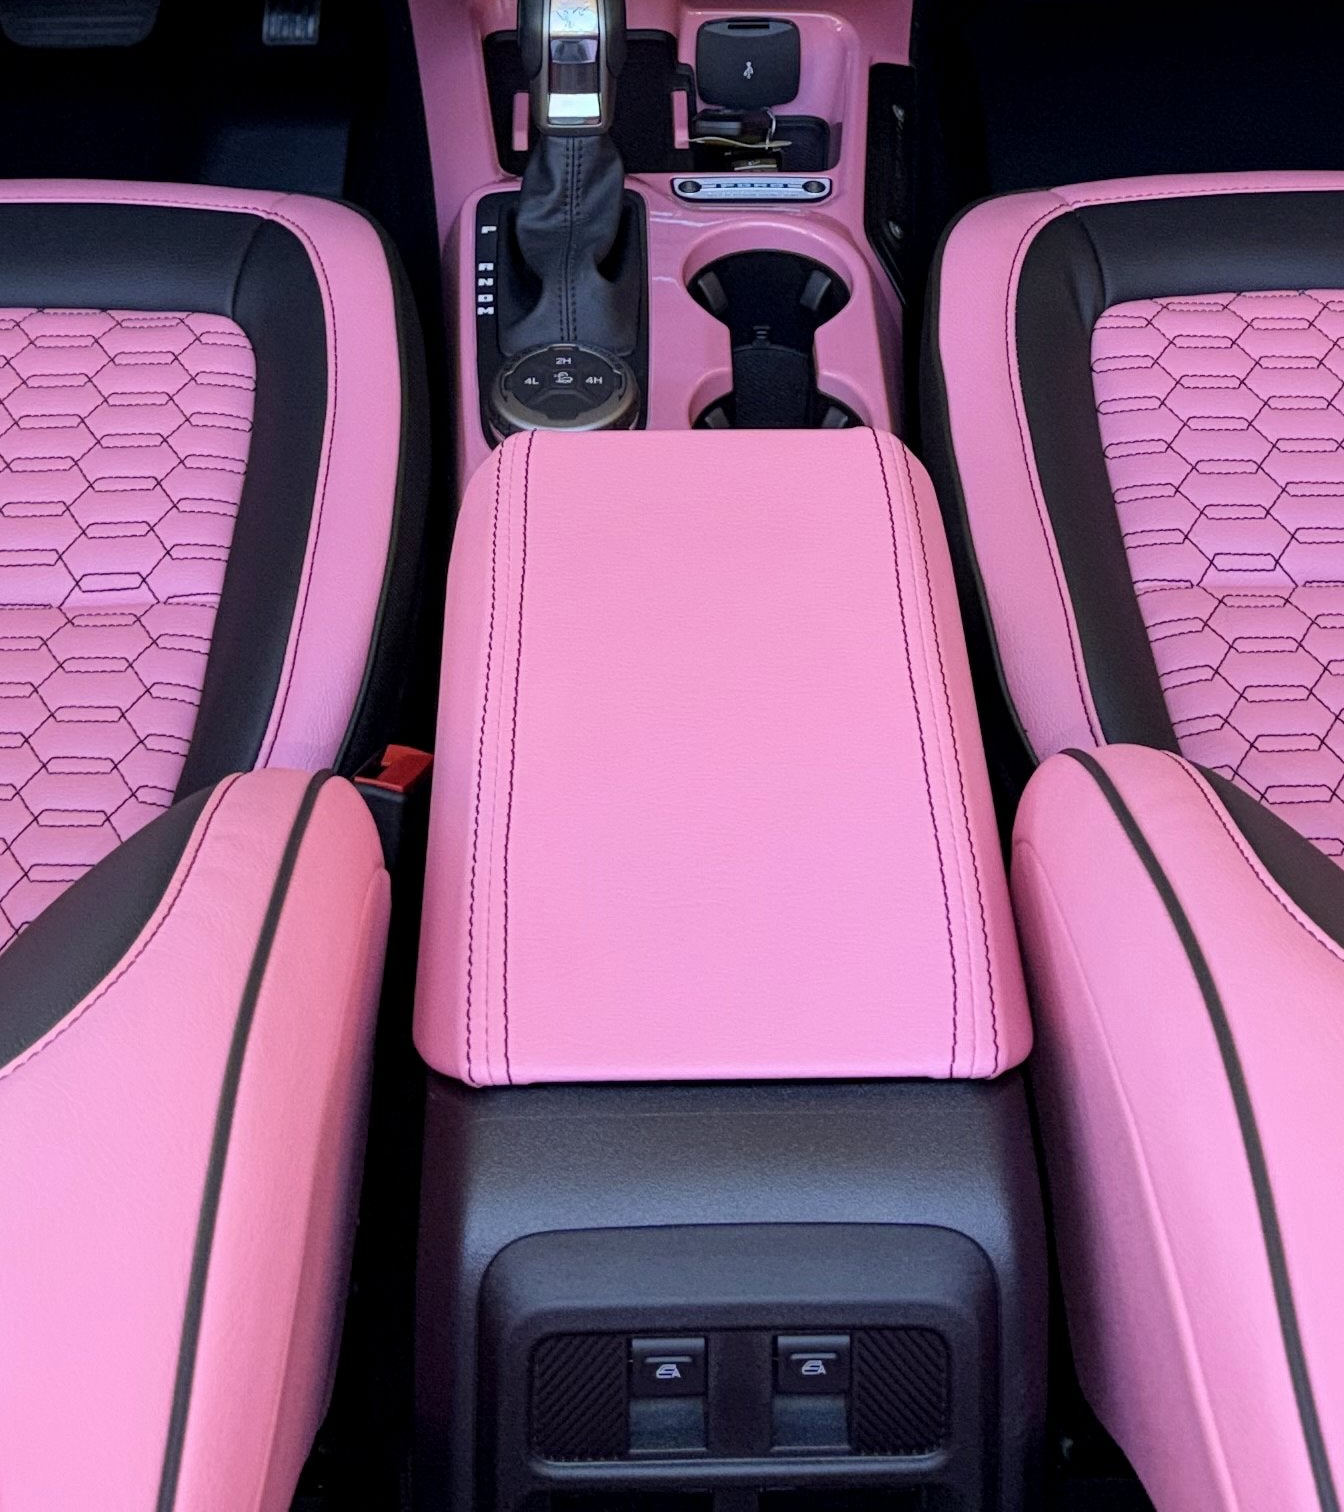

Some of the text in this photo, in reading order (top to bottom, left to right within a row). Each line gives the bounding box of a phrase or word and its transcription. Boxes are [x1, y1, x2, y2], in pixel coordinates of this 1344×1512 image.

[478, 277, 494, 287] N
[478, 294, 494, 303] D
[477, 306, 495, 316] M
[555, 357, 572, 365] 2H
[523, 377, 539, 385] 4L
[585, 376, 603, 385] 4H
